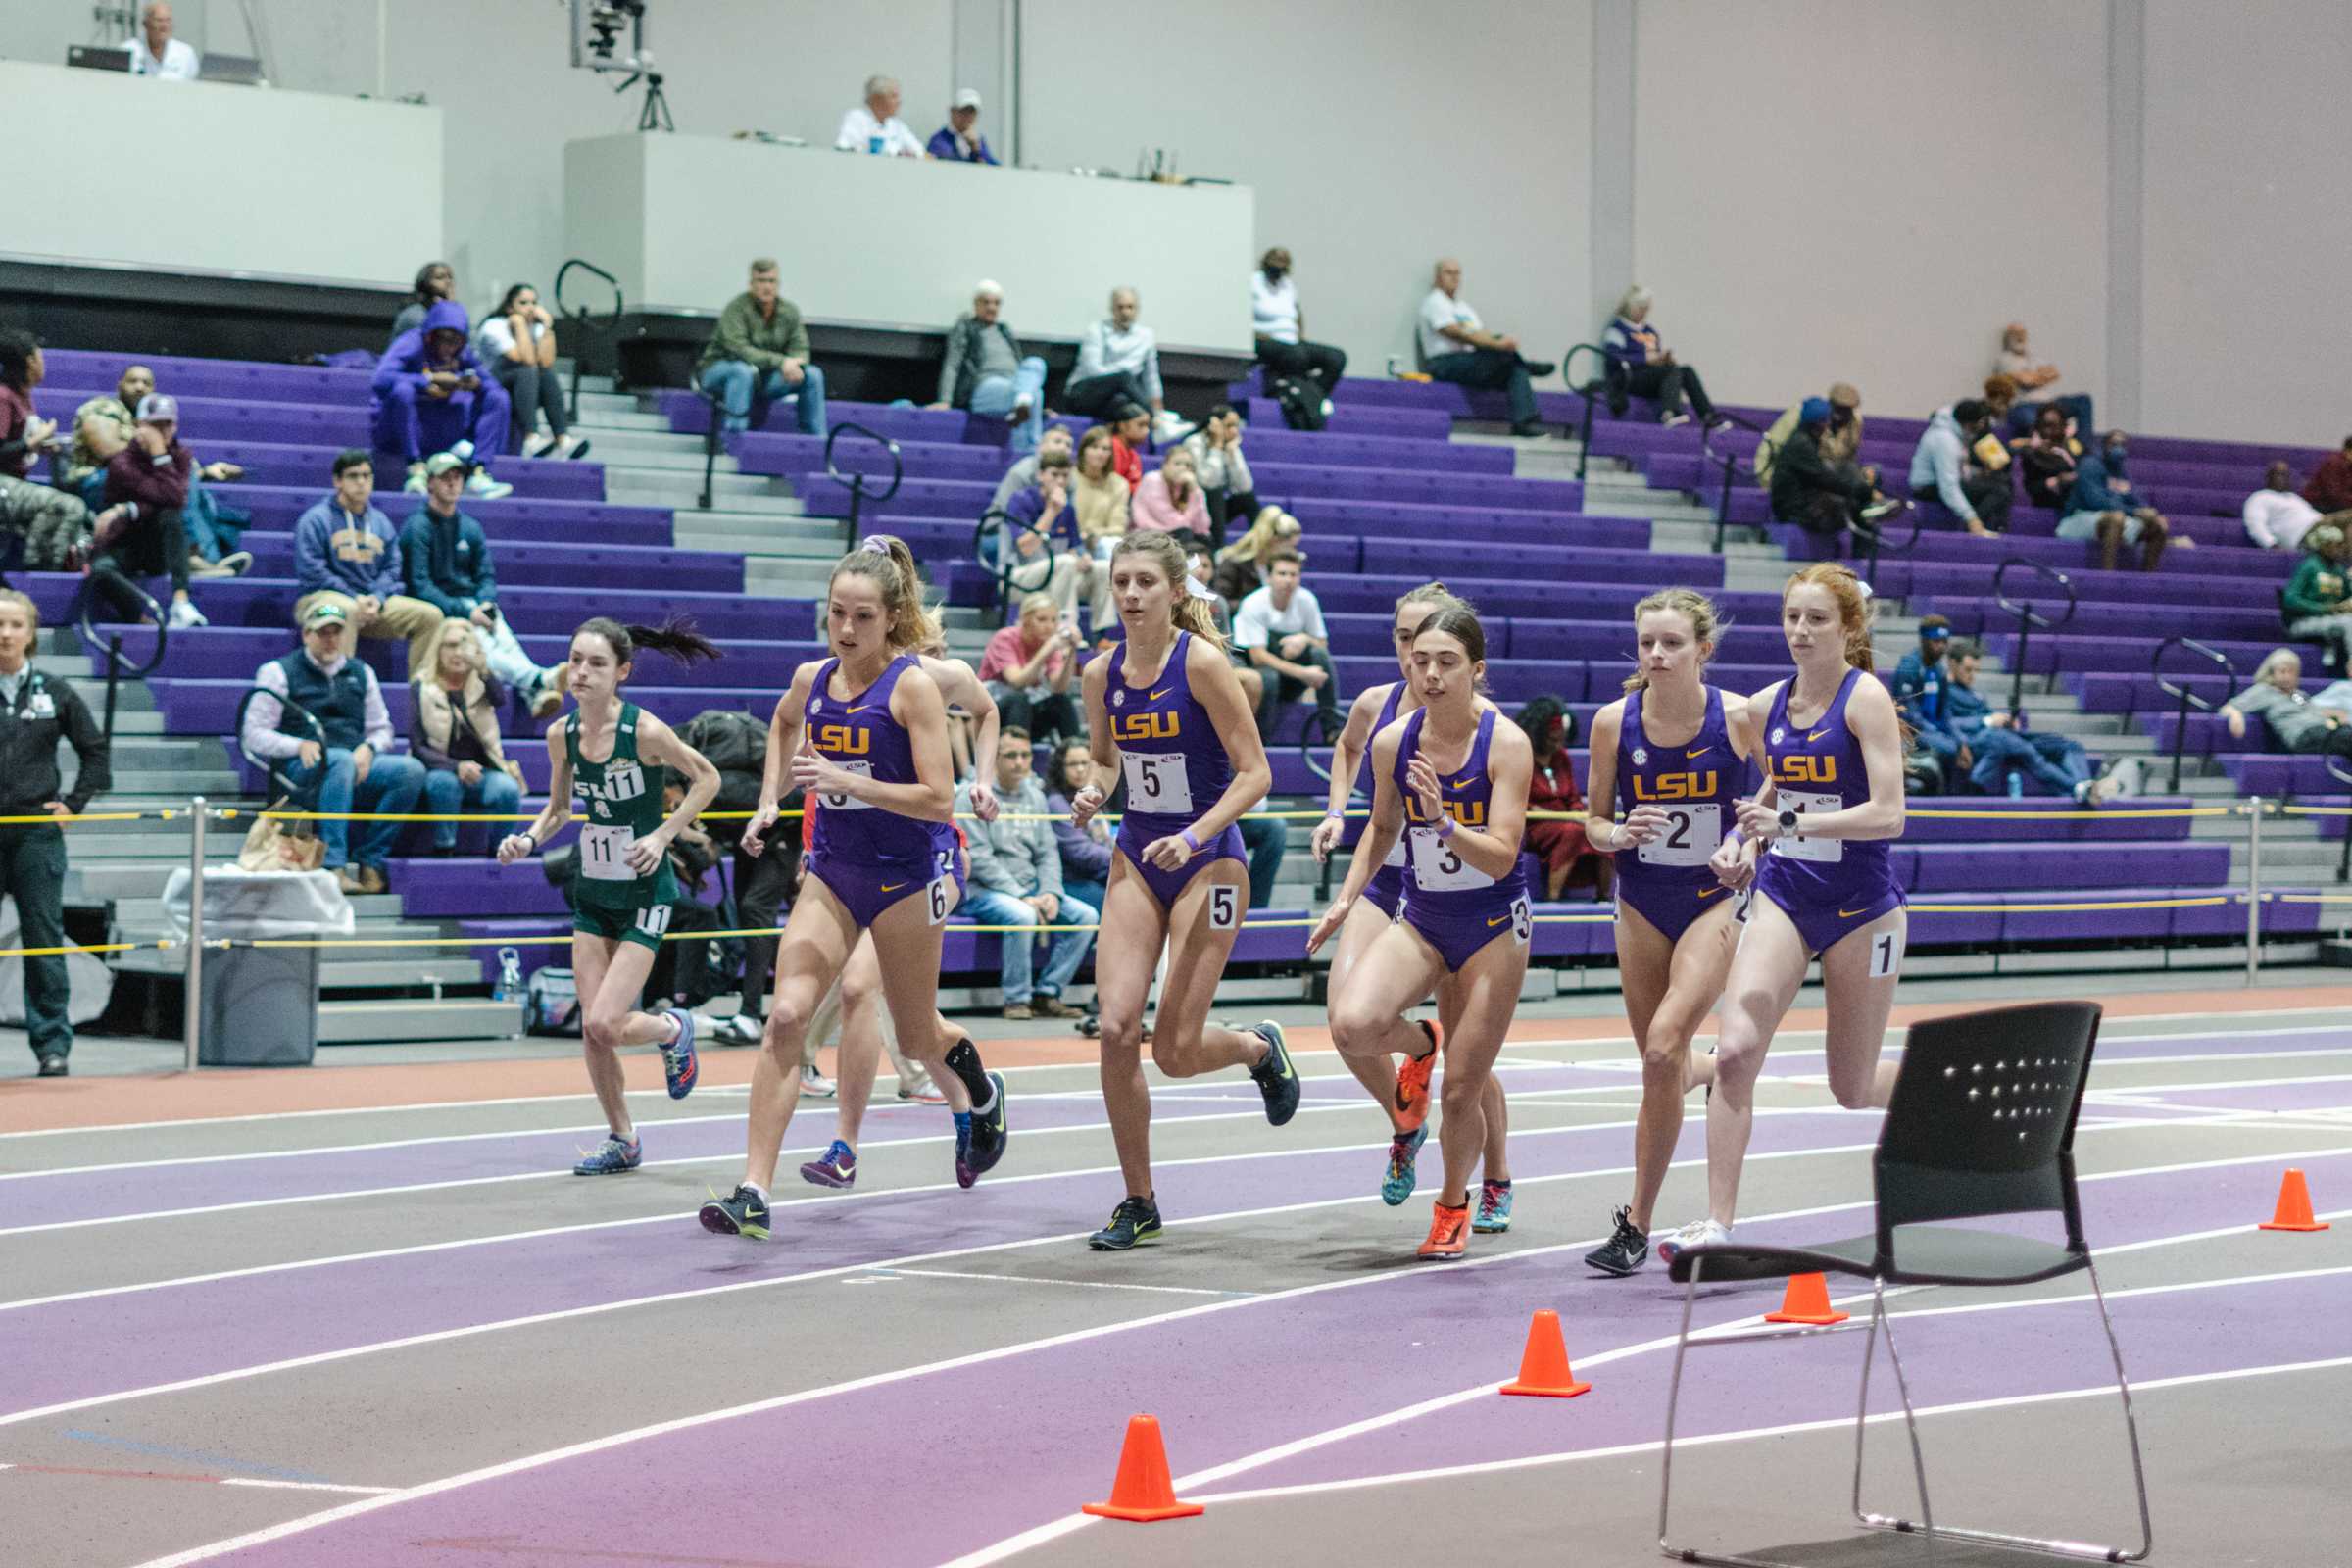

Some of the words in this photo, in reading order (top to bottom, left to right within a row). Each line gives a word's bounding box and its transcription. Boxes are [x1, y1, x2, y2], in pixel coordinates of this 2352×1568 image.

[806, 723, 870, 754] LSU
[1110, 711, 1180, 741] LSU
[608, 771, 635, 799] 11
[1142, 760, 1160, 798] 5
[1633, 770, 1717, 801] LSU
[1767, 755, 1837, 783] LSU
[574, 782, 607, 800] SL
[1667, 811, 1690, 849] 2
[591, 836, 610, 862] 11
[1437, 839, 1461, 874] 3
[932, 881, 945, 919] 6
[1213, 888, 1232, 925] 5
[1515, 900, 1529, 939] 3
[1878, 935, 1891, 973] 1
